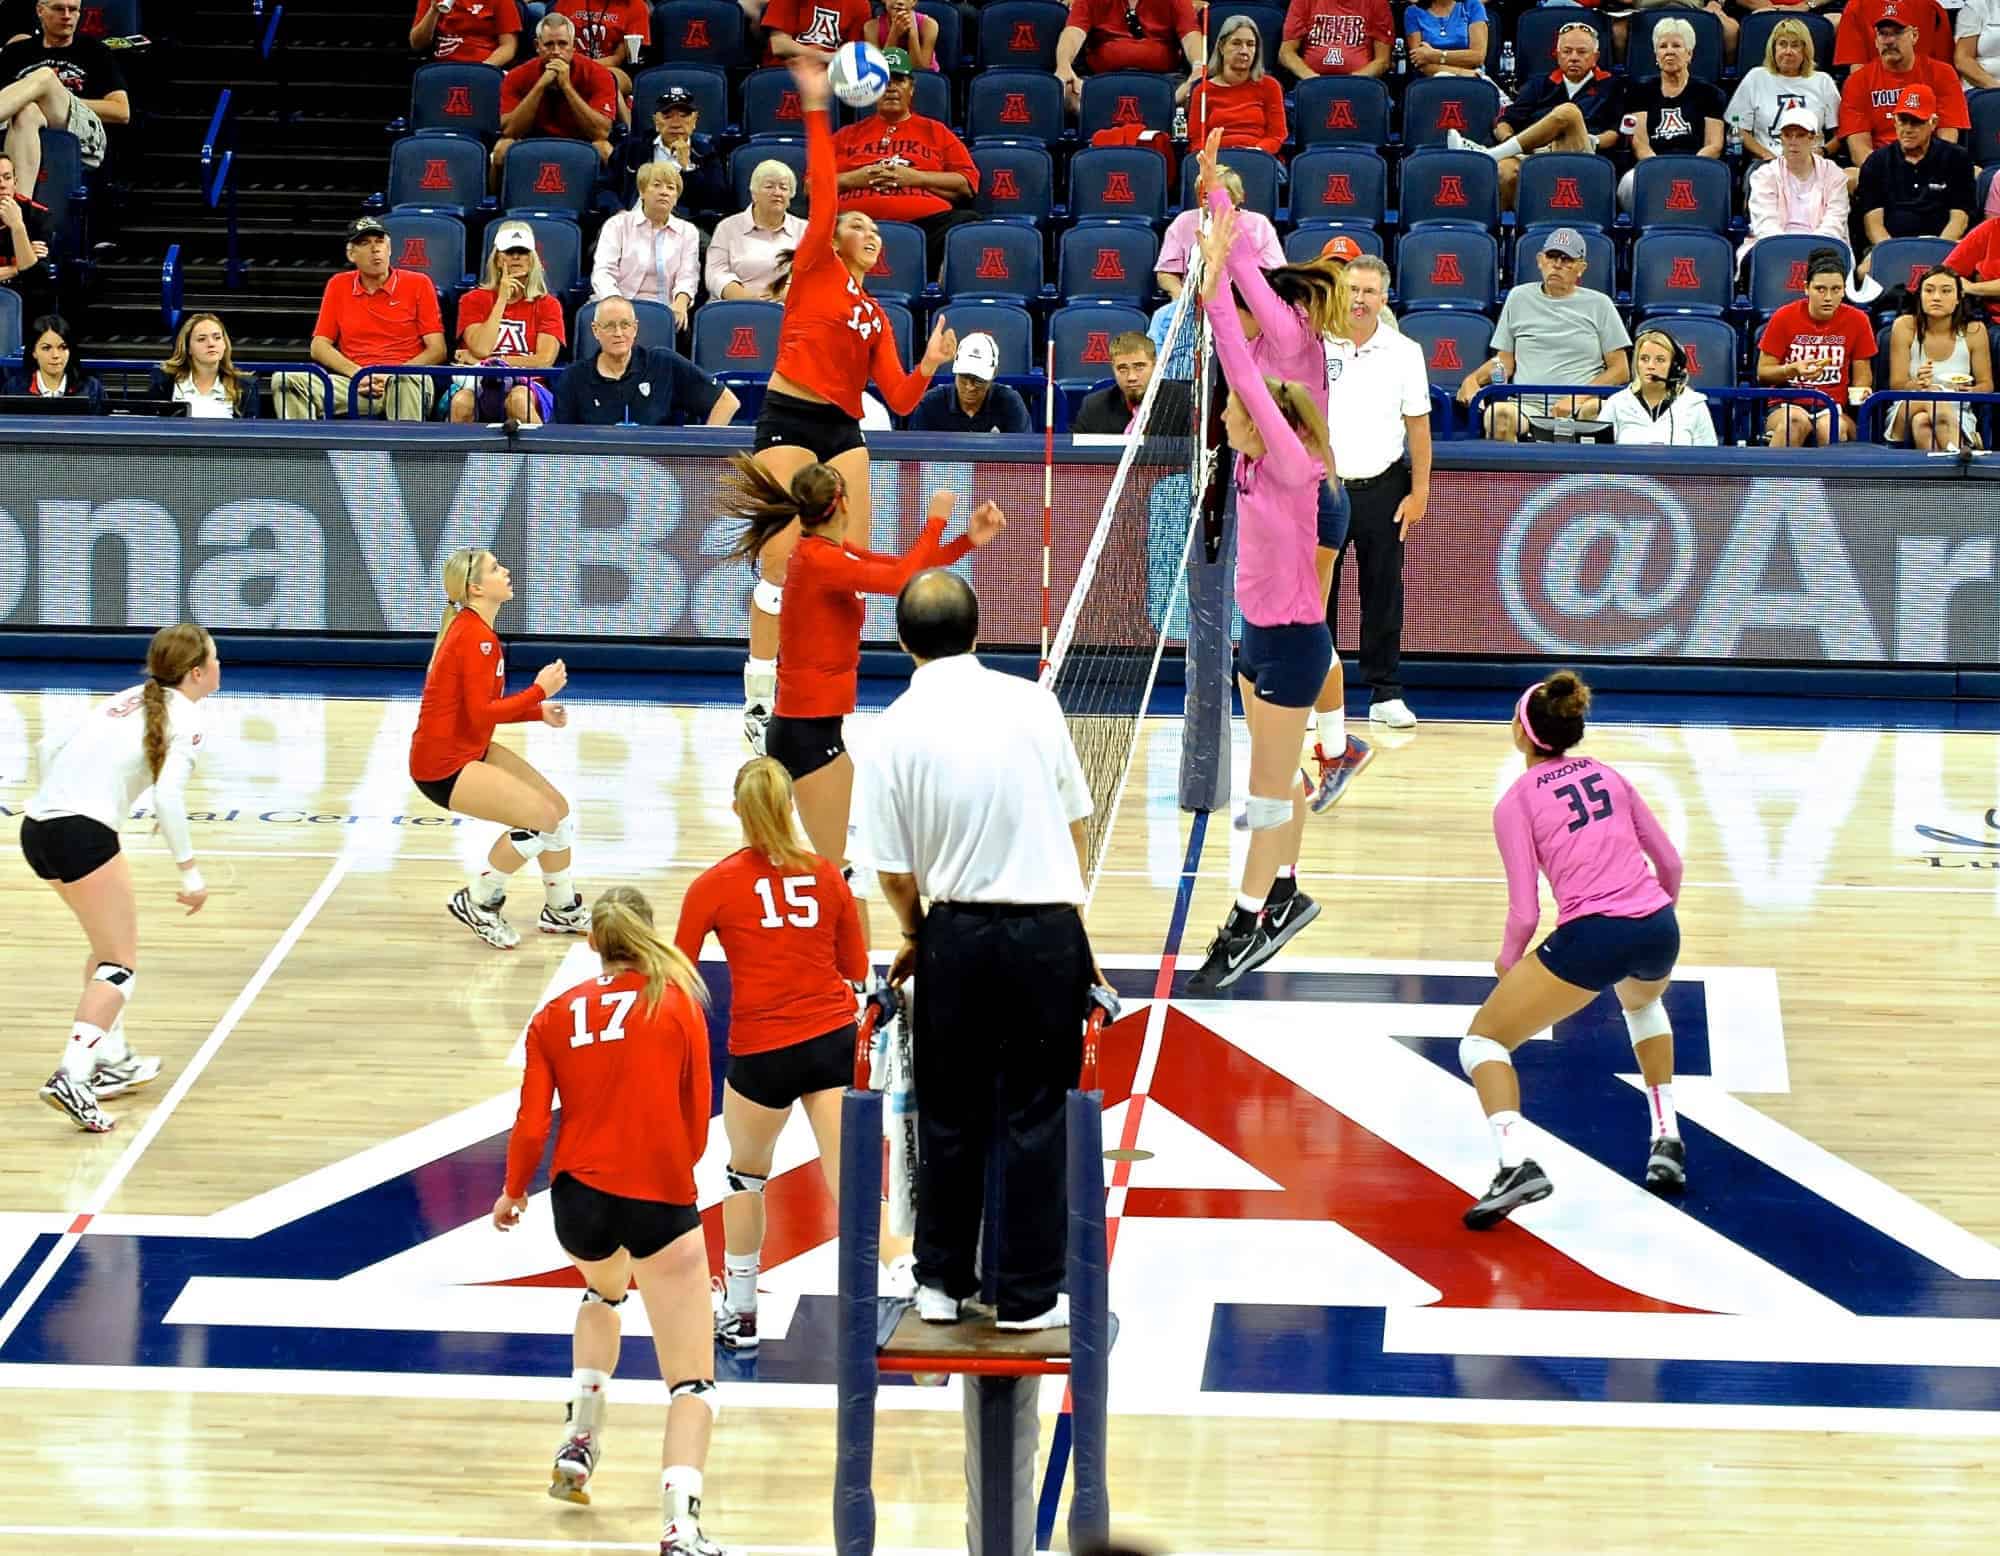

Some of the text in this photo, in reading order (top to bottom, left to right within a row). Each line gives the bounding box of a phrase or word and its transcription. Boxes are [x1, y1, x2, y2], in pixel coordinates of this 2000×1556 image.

[683, 20, 710, 48] A
[796, 6, 841, 48] A
[1010, 22, 1039, 51] A
[444, 87, 471, 116] A
[1002, 94, 1030, 123] A
[1113, 96, 1142, 123] A
[1327, 100, 1357, 129] A
[1436, 101, 1466, 130] A
[420, 160, 452, 190] A
[534, 163, 565, 193] A
[992, 170, 1019, 200] A
[1103, 173, 1135, 203] A
[1322, 175, 1355, 205] A
[1435, 176, 1466, 206] A
[1550, 178, 1582, 209] A
[1665, 180, 1697, 211] A
[399, 238, 430, 268] A
[976, 248, 1009, 279] A
[1093, 249, 1126, 280] A
[1431, 254, 1464, 285] A
[1667, 258, 1700, 289] A
[727, 328, 760, 359] A
[1082, 333, 1111, 364] A
[1429, 339, 1463, 370] A
[1536, 758, 1593, 789] ARIZONA
[1553, 772, 1614, 834] 35
[754, 875, 820, 929] 15
[569, 990, 638, 1049] 17
